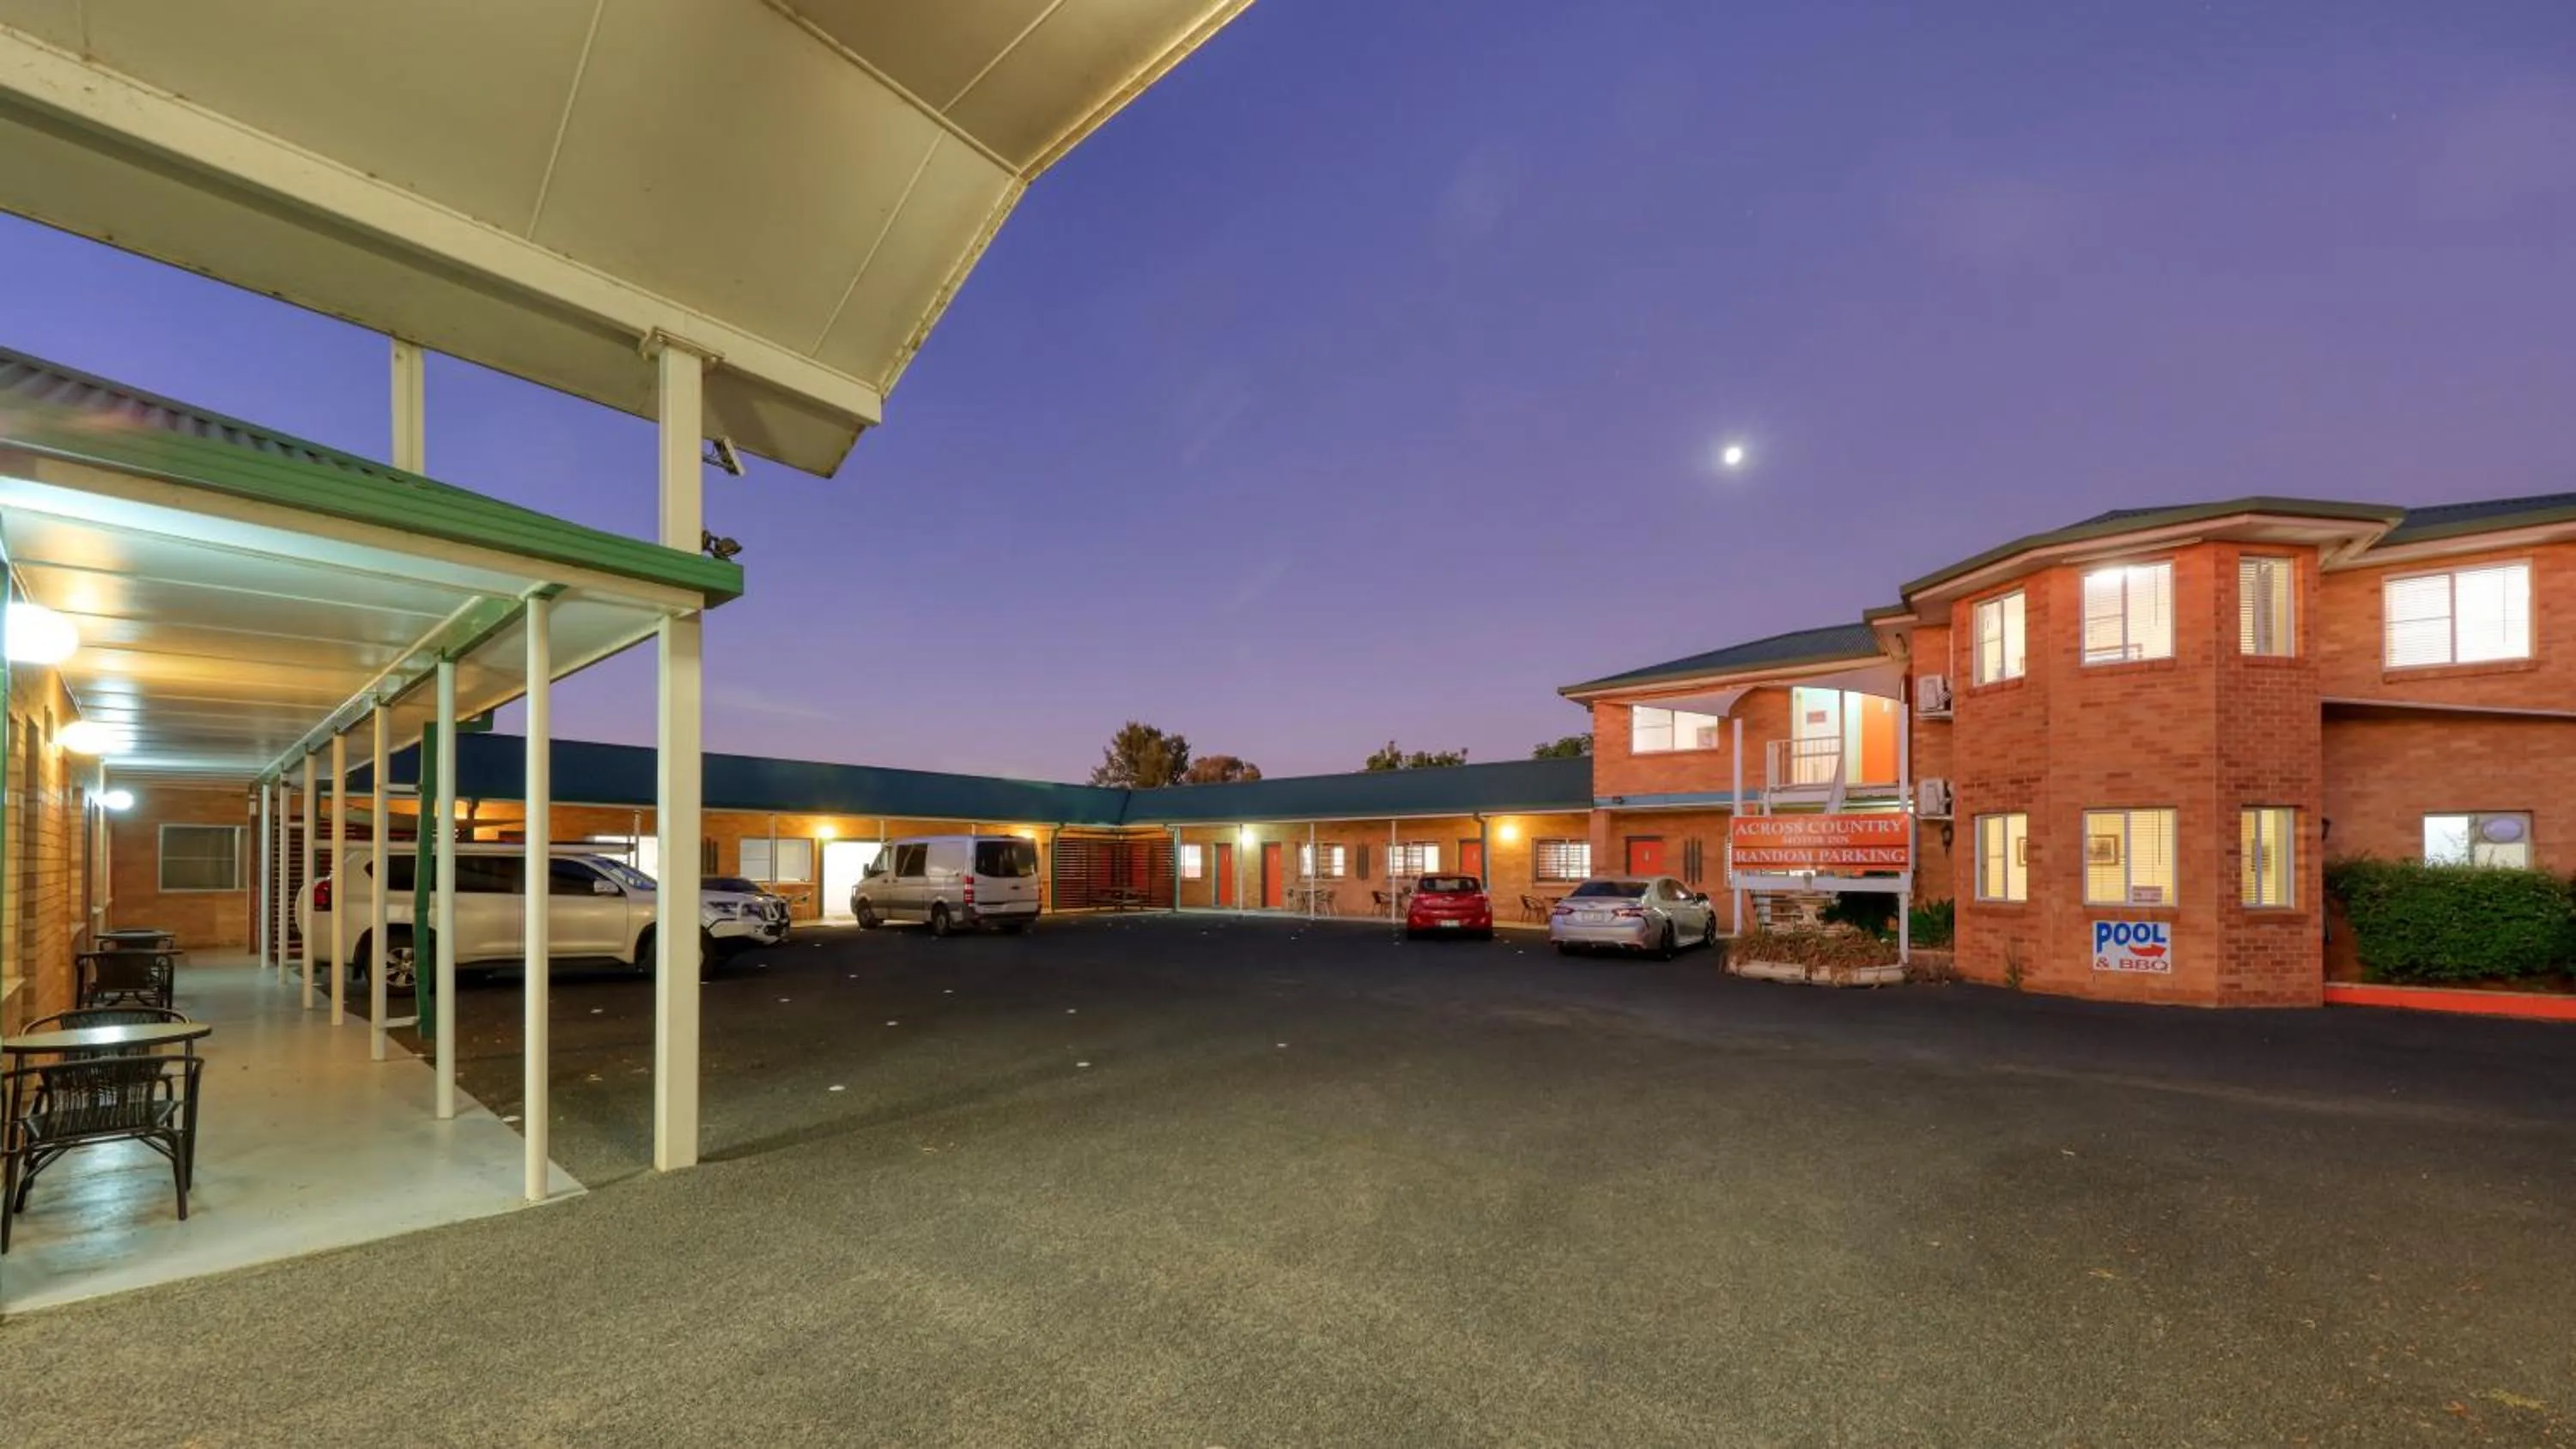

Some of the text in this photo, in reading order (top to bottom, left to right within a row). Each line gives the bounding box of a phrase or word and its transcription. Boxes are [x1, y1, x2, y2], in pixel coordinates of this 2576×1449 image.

[1735, 819, 1904, 835] ACROSS COUNTRY
[1735, 848, 1905, 863] RANDOM PARKING
[2096, 922, 2167, 954] POOL
[2095, 956, 2168, 971] & BBQ
